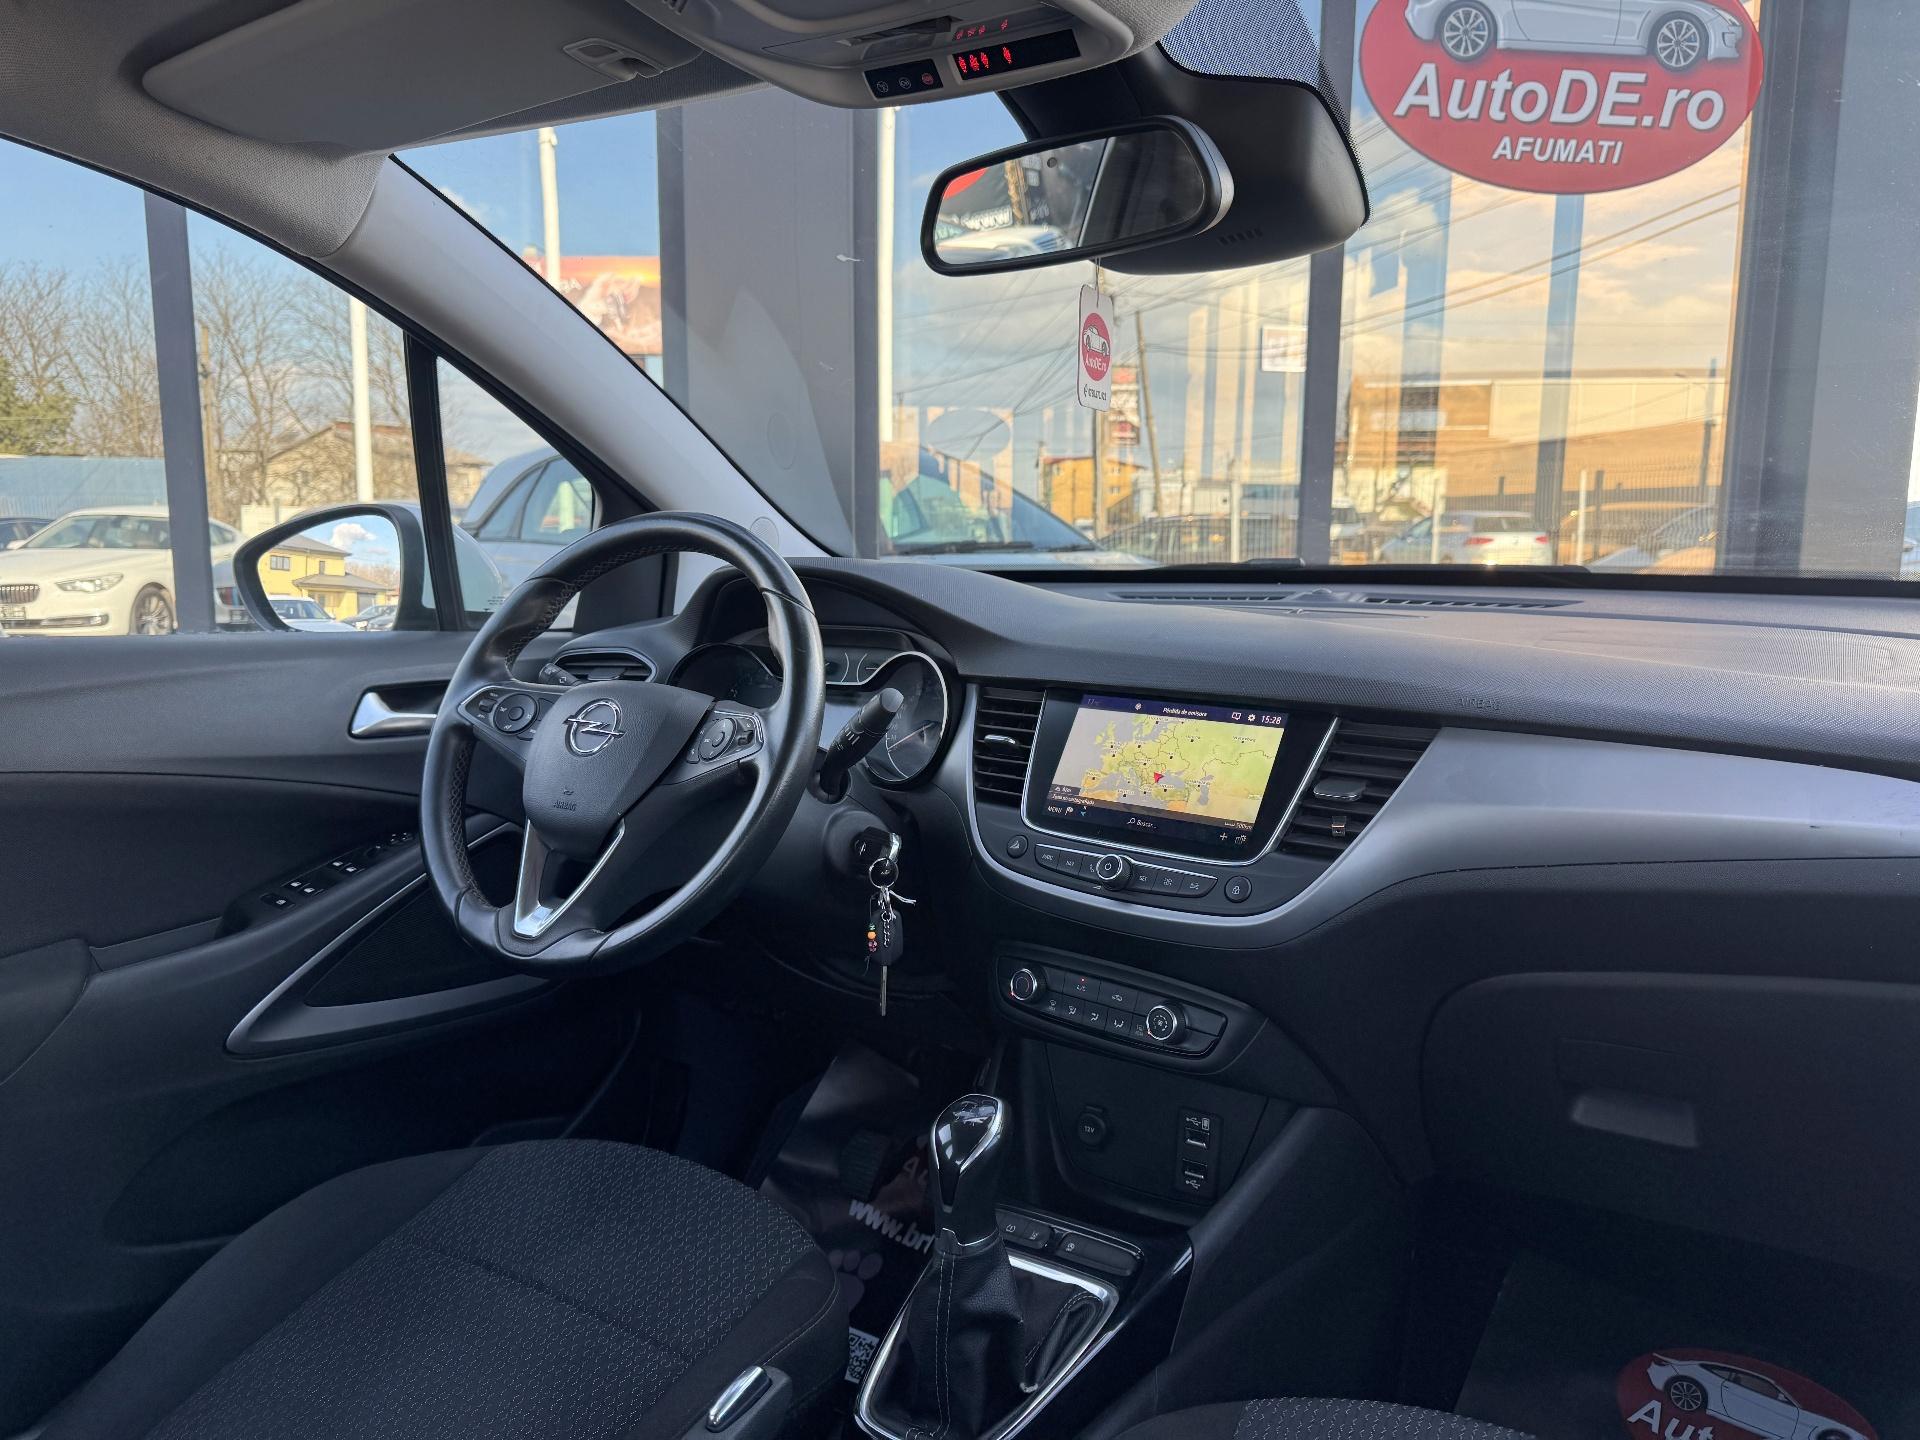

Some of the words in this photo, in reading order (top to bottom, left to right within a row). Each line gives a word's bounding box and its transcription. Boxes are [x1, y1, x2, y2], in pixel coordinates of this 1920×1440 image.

[1394, 62, 1725, 131] AutoDE.ro
[1492, 136, 1623, 164] AFUMATI
[1261, 715, 1282, 725] 15:28
